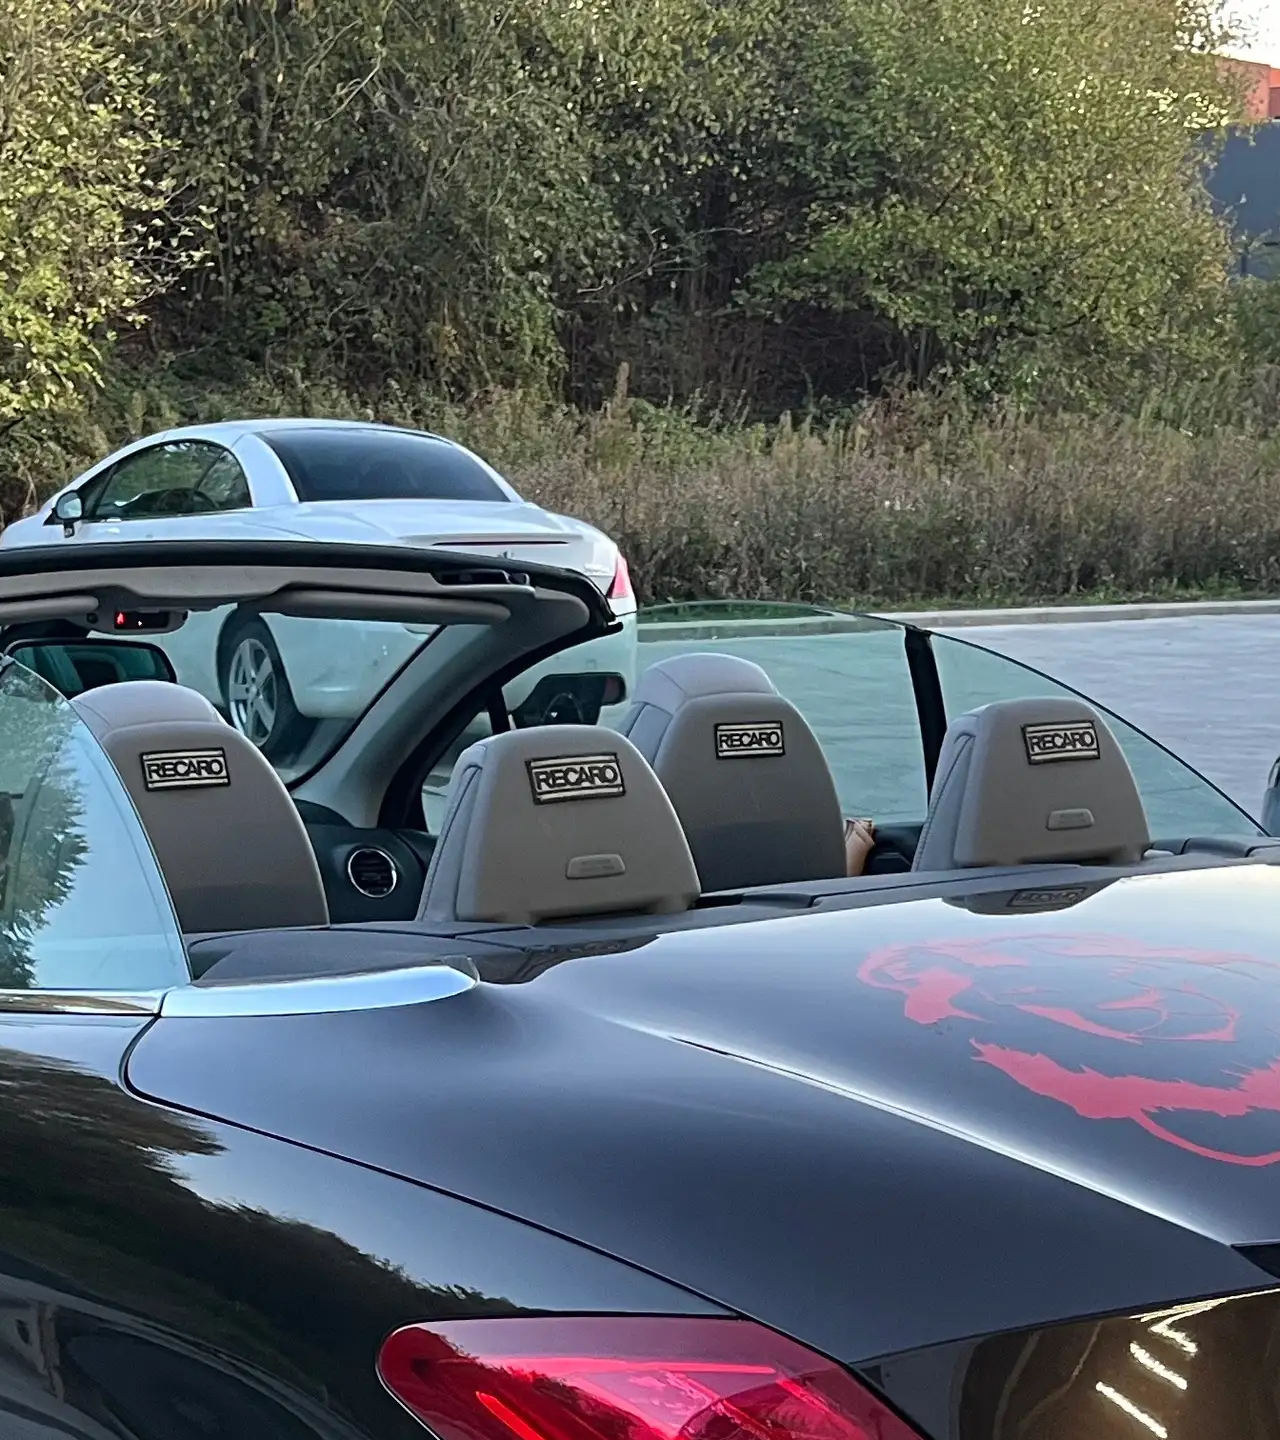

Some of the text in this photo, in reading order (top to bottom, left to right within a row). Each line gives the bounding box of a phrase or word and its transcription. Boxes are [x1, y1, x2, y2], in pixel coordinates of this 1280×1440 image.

[718, 730, 780, 749] RECARO
[1027, 730, 1095, 752] RECARO
[146, 758, 224, 780] RECARO
[534, 764, 619, 790] RECARO
